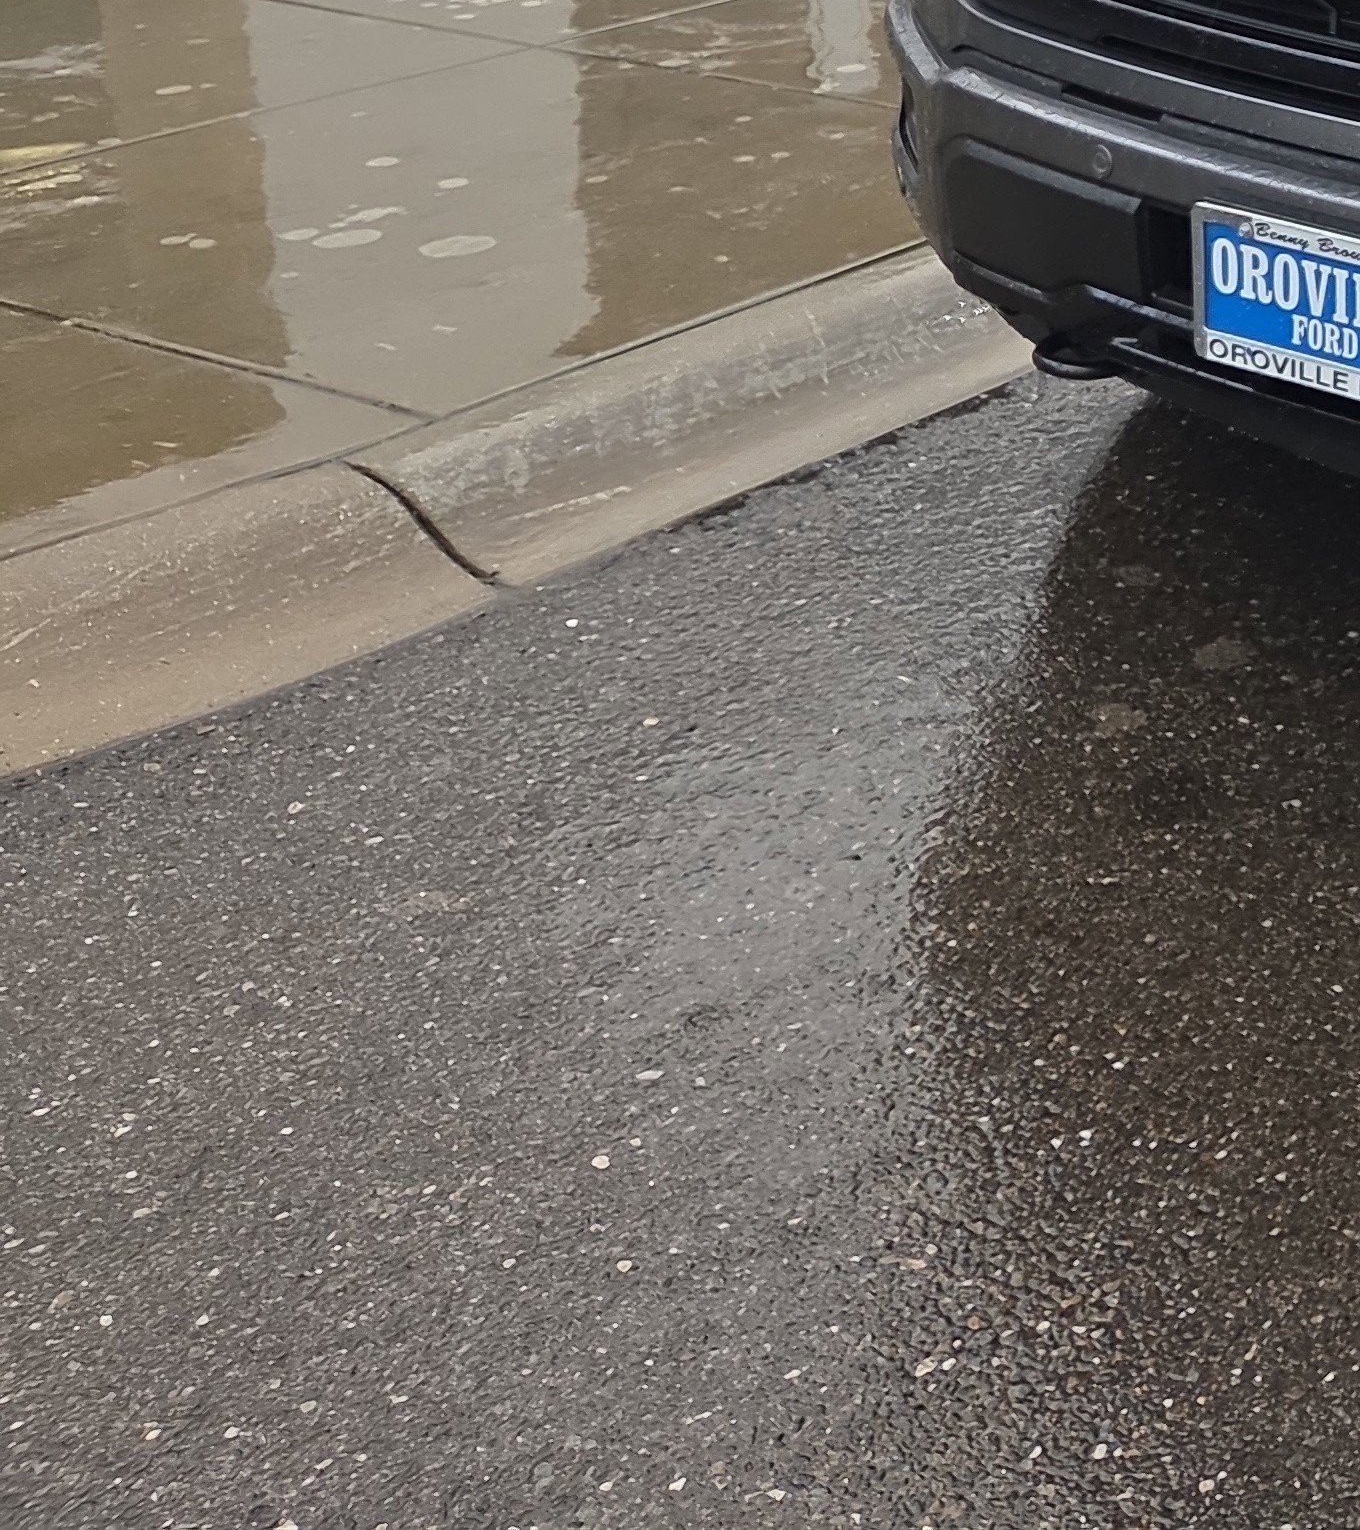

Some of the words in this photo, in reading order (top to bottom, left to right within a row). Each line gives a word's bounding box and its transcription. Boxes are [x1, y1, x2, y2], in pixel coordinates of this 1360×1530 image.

[1254, 222, 1309, 251] Benny
[1291, 314, 1359, 360] FORD
[1209, 337, 1349, 393] OROVILLE
